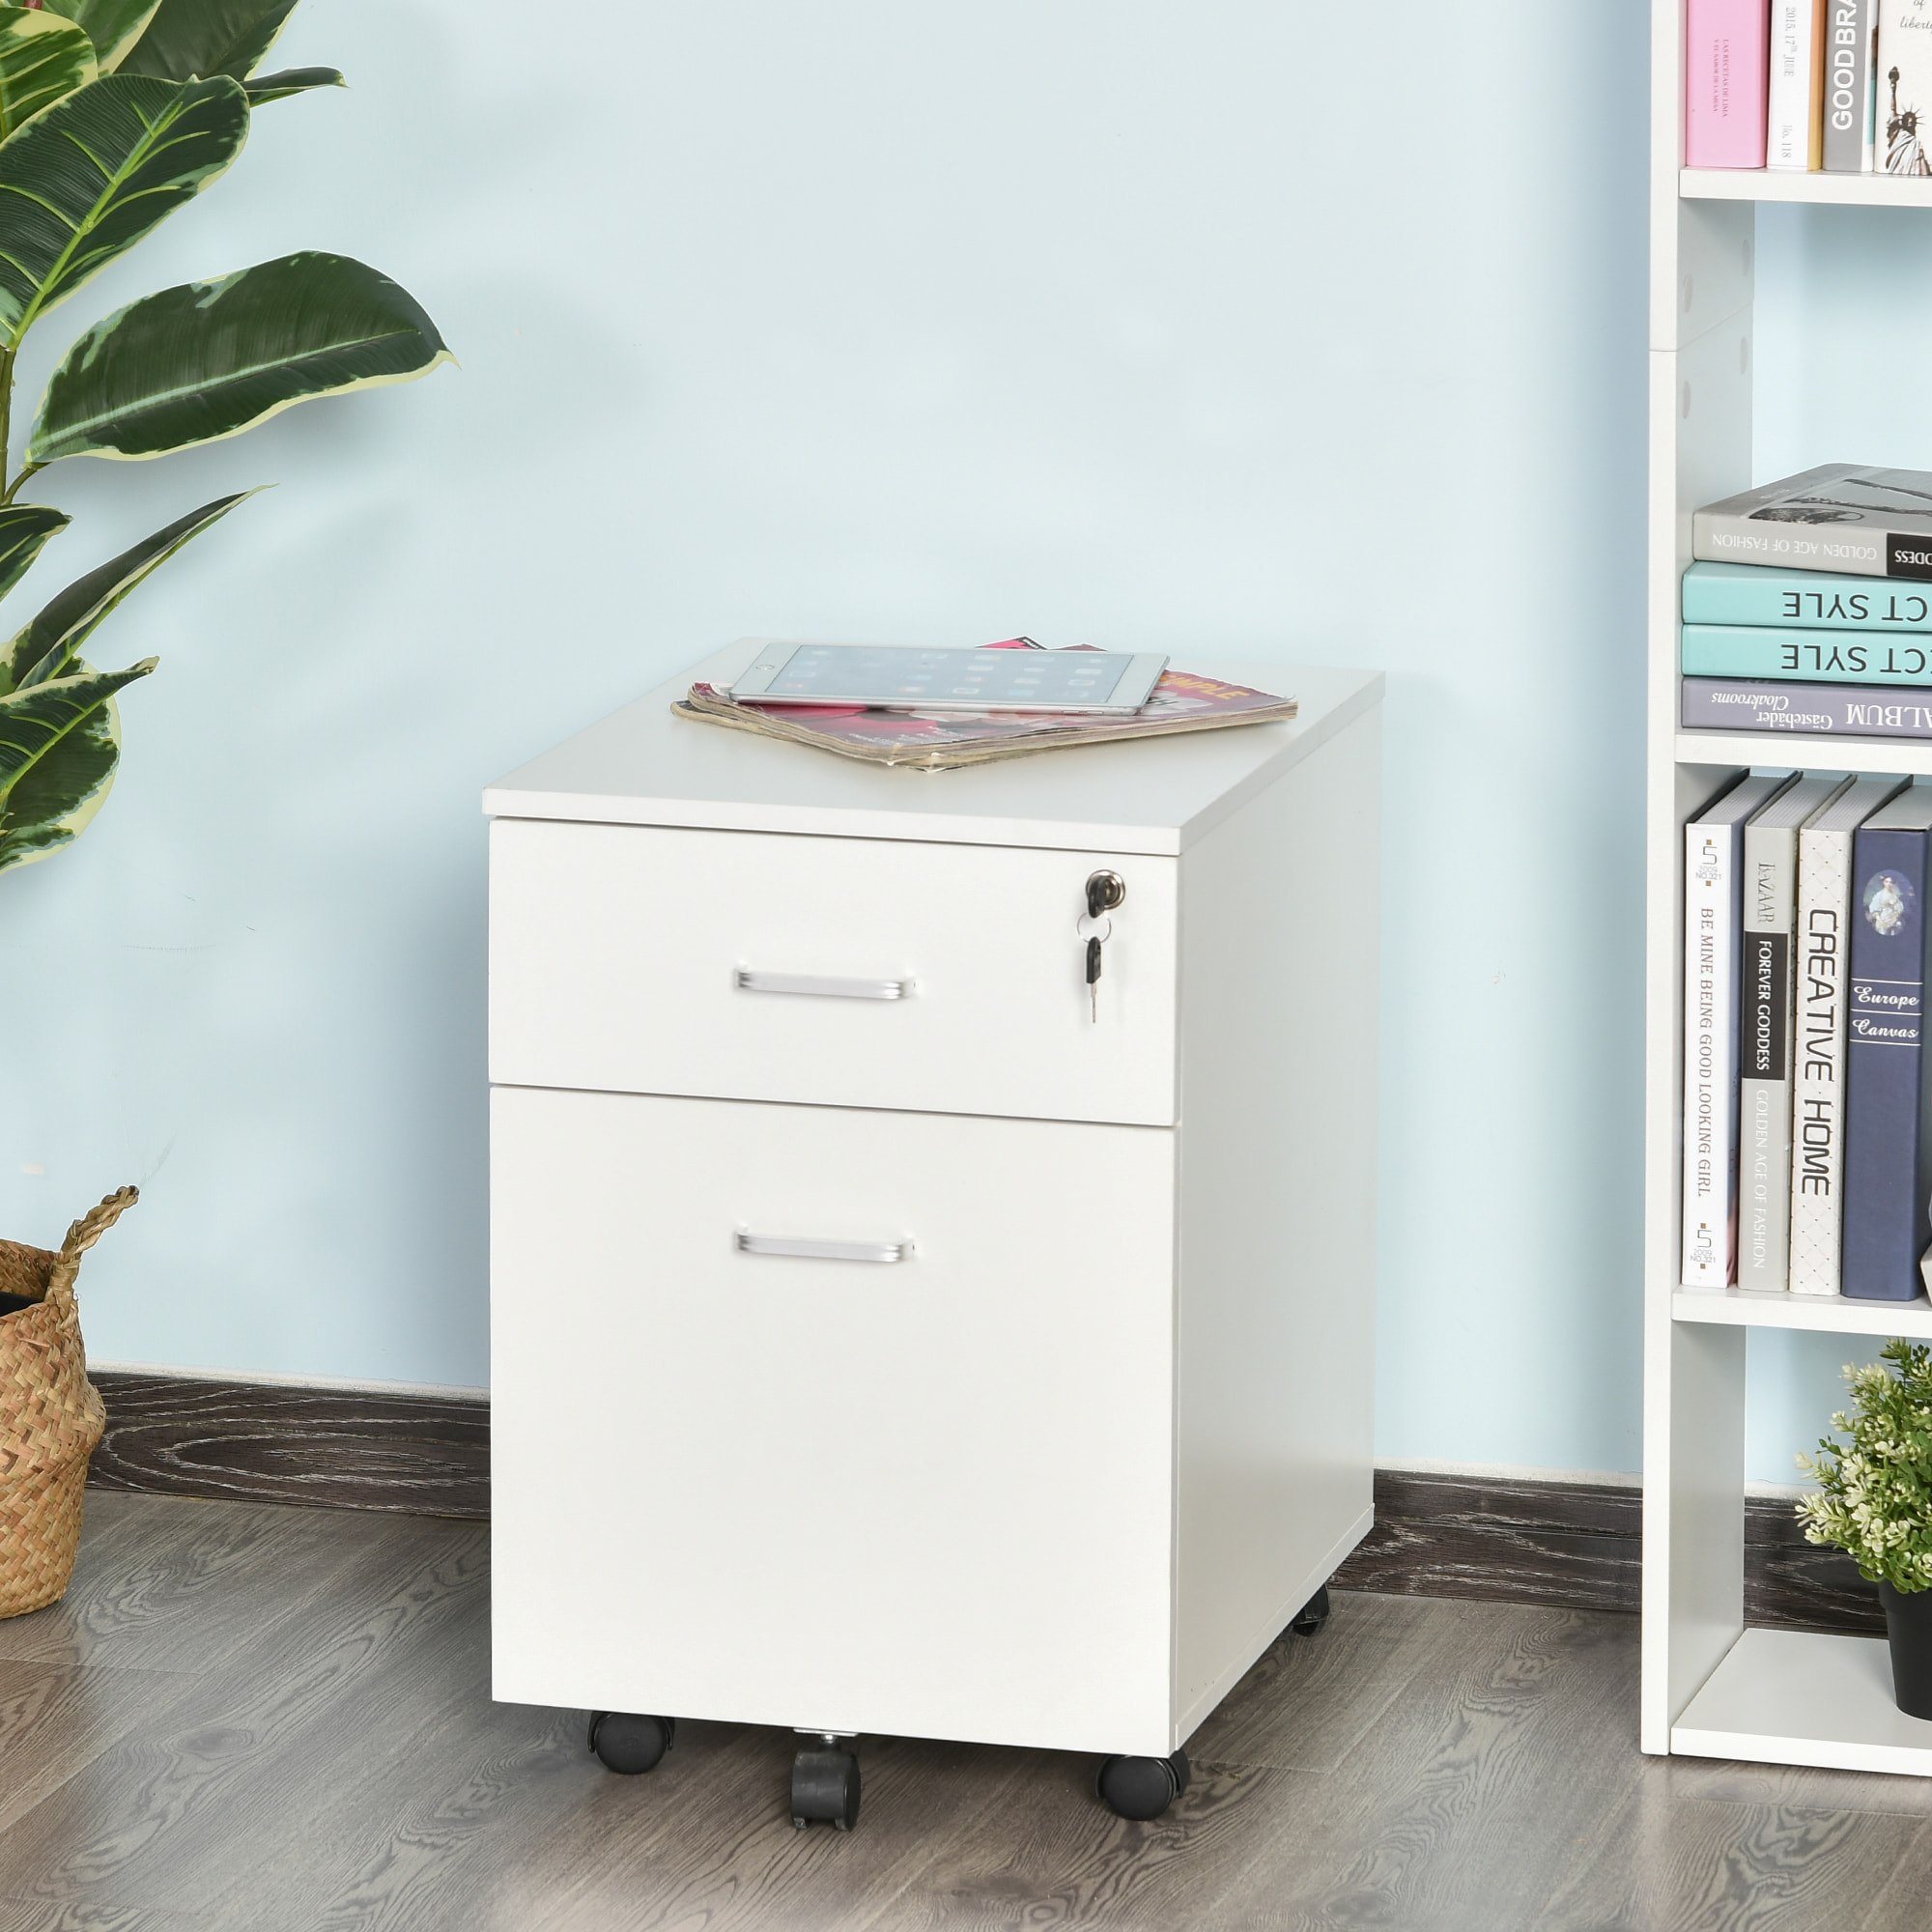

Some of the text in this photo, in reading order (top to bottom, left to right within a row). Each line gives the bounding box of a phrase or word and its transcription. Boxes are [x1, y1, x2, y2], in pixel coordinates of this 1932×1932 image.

[1832, 49, 1855, 130] GOOD
[1712, 533, 1878, 560] GOLDEN AGE OF FASHION
[1782, 591, 1870, 620] SYLE
[1780, 644, 1932, 674] CT SYLE
[1711, 692, 1789, 711] Cloakrooms
[1756, 711, 1833, 729] Gästebäder
[1756, 940, 1773, 1071] FOREVER GODDESS
[1853, 985, 1920, 1010] Europe
[1852, 1018, 1919, 1038] Canvas
[1697, 908, 1714, 1197] BE MINE BEING GOOD LOOKING GIRL
[1802, 909, 1837, 1197] CREATIVE HOME
[1752, 1090, 1769, 1269] GOLDEN AGE OF FASHION
